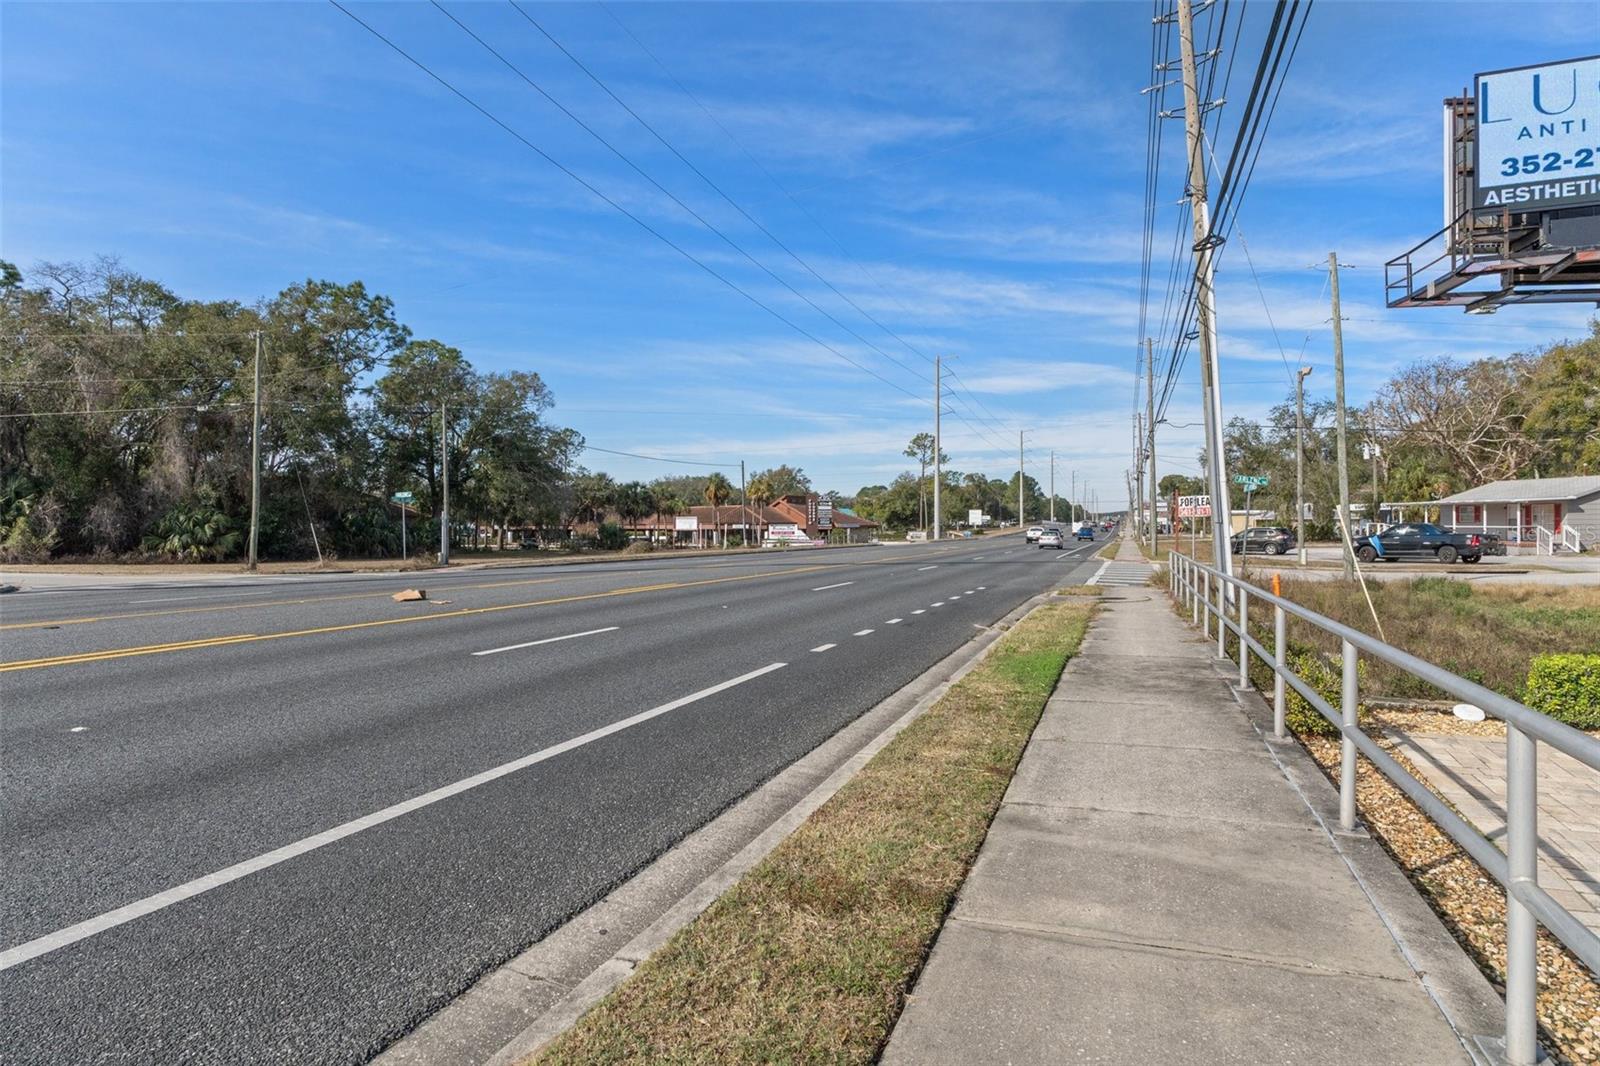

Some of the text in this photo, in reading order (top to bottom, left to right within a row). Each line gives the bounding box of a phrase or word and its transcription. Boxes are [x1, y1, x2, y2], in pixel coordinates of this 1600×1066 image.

[1481, 68, 1600, 124] LU
[1517, 118, 1586, 140] ANTI
[1501, 147, 1600, 177] 352-2
[1483, 178, 1600, 206] AESTHETI
[1196, 497, 1211, 507] LEA
